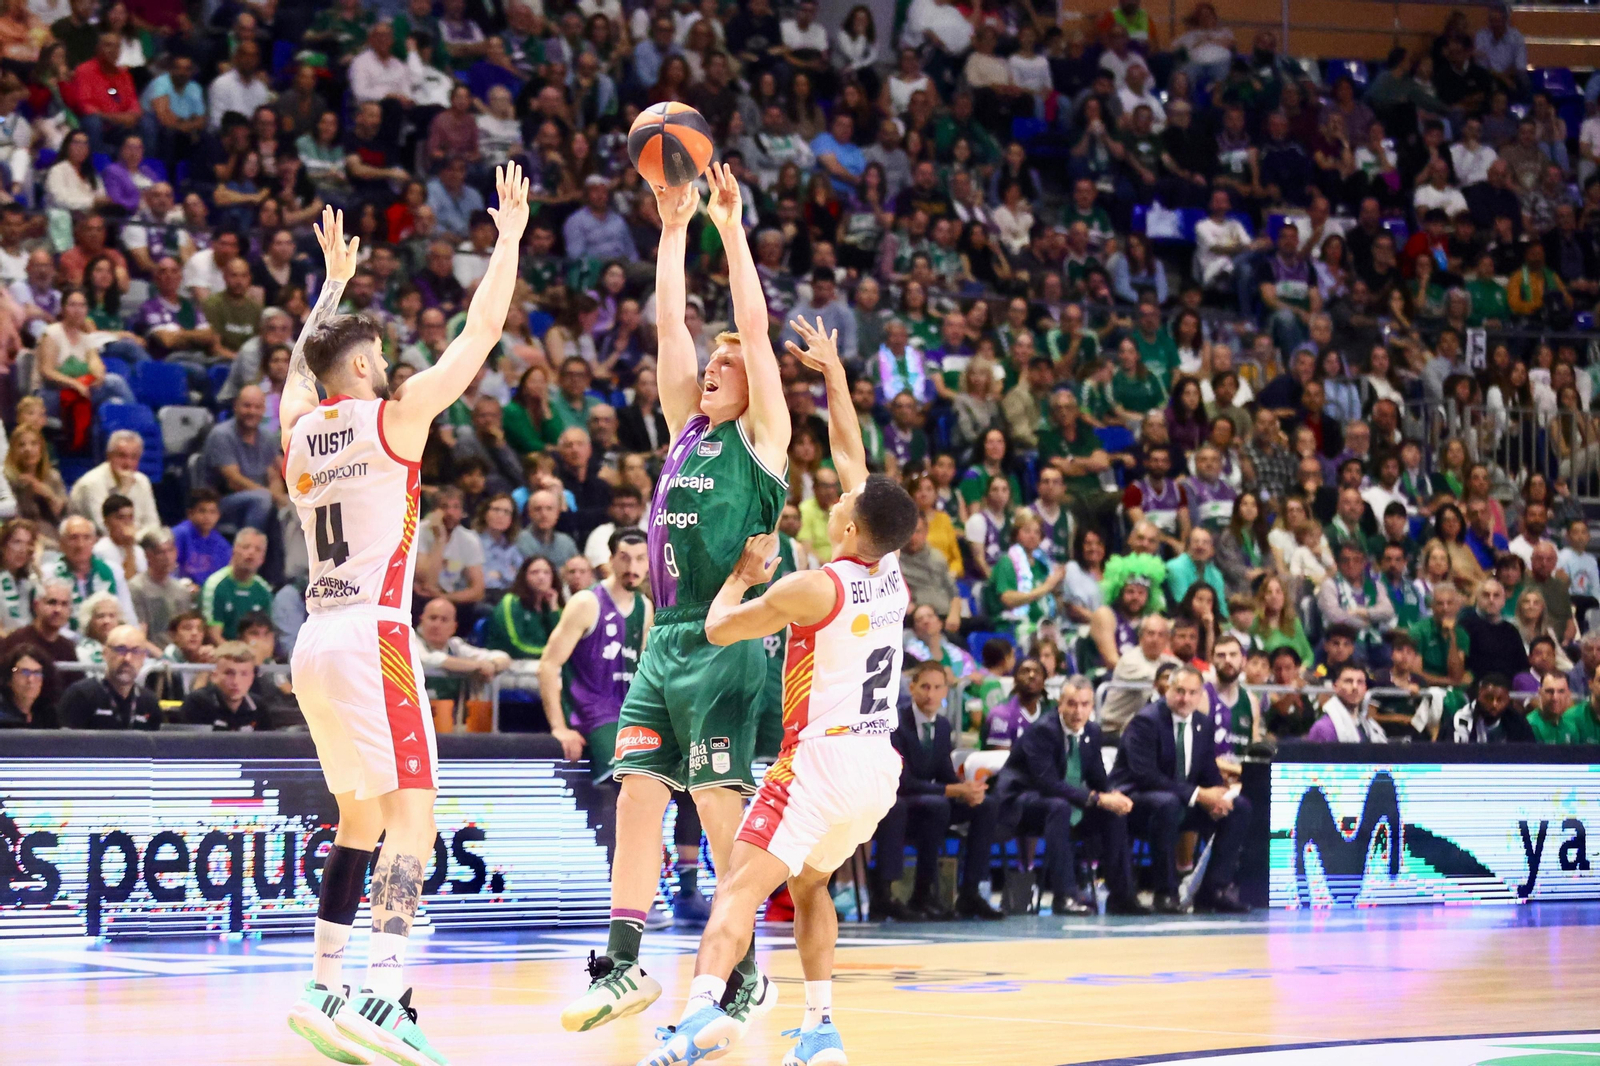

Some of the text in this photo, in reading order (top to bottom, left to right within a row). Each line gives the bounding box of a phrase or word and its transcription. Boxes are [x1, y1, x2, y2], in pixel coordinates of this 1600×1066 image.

[307, 427, 355, 457] YUSTA
[315, 502, 350, 568] 4
[653, 508, 698, 529] álaga
[664, 542, 680, 577] 9
[859, 645, 897, 714] 2
[1517, 818, 1592, 898] ya
